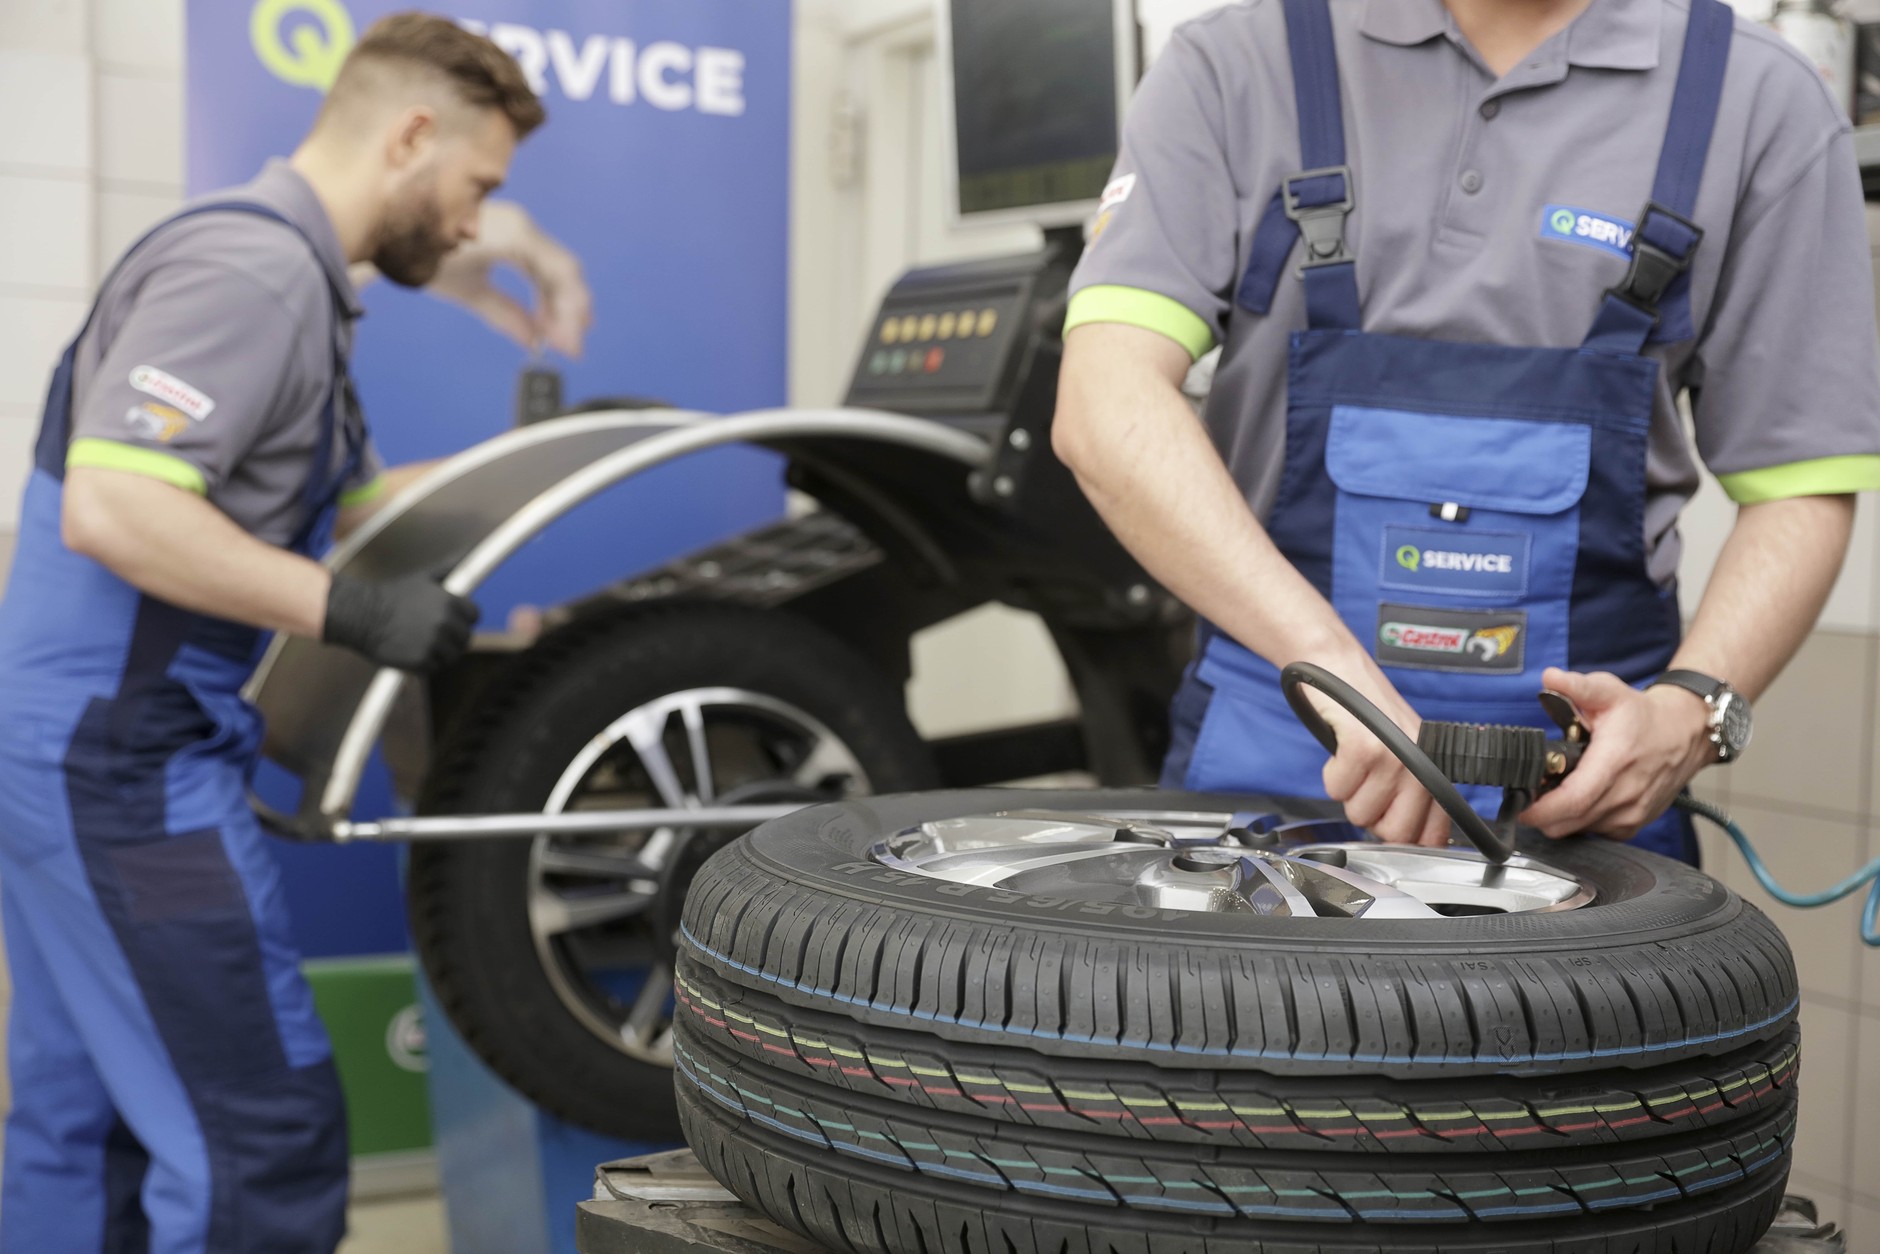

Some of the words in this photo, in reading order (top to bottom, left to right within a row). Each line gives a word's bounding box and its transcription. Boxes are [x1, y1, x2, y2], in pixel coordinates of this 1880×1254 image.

[458, 18, 746, 117] RVICE
[1551, 209, 1575, 235] Q
[1396, 545, 1420, 572] Q
[1423, 550, 1512, 573] SERVICE
